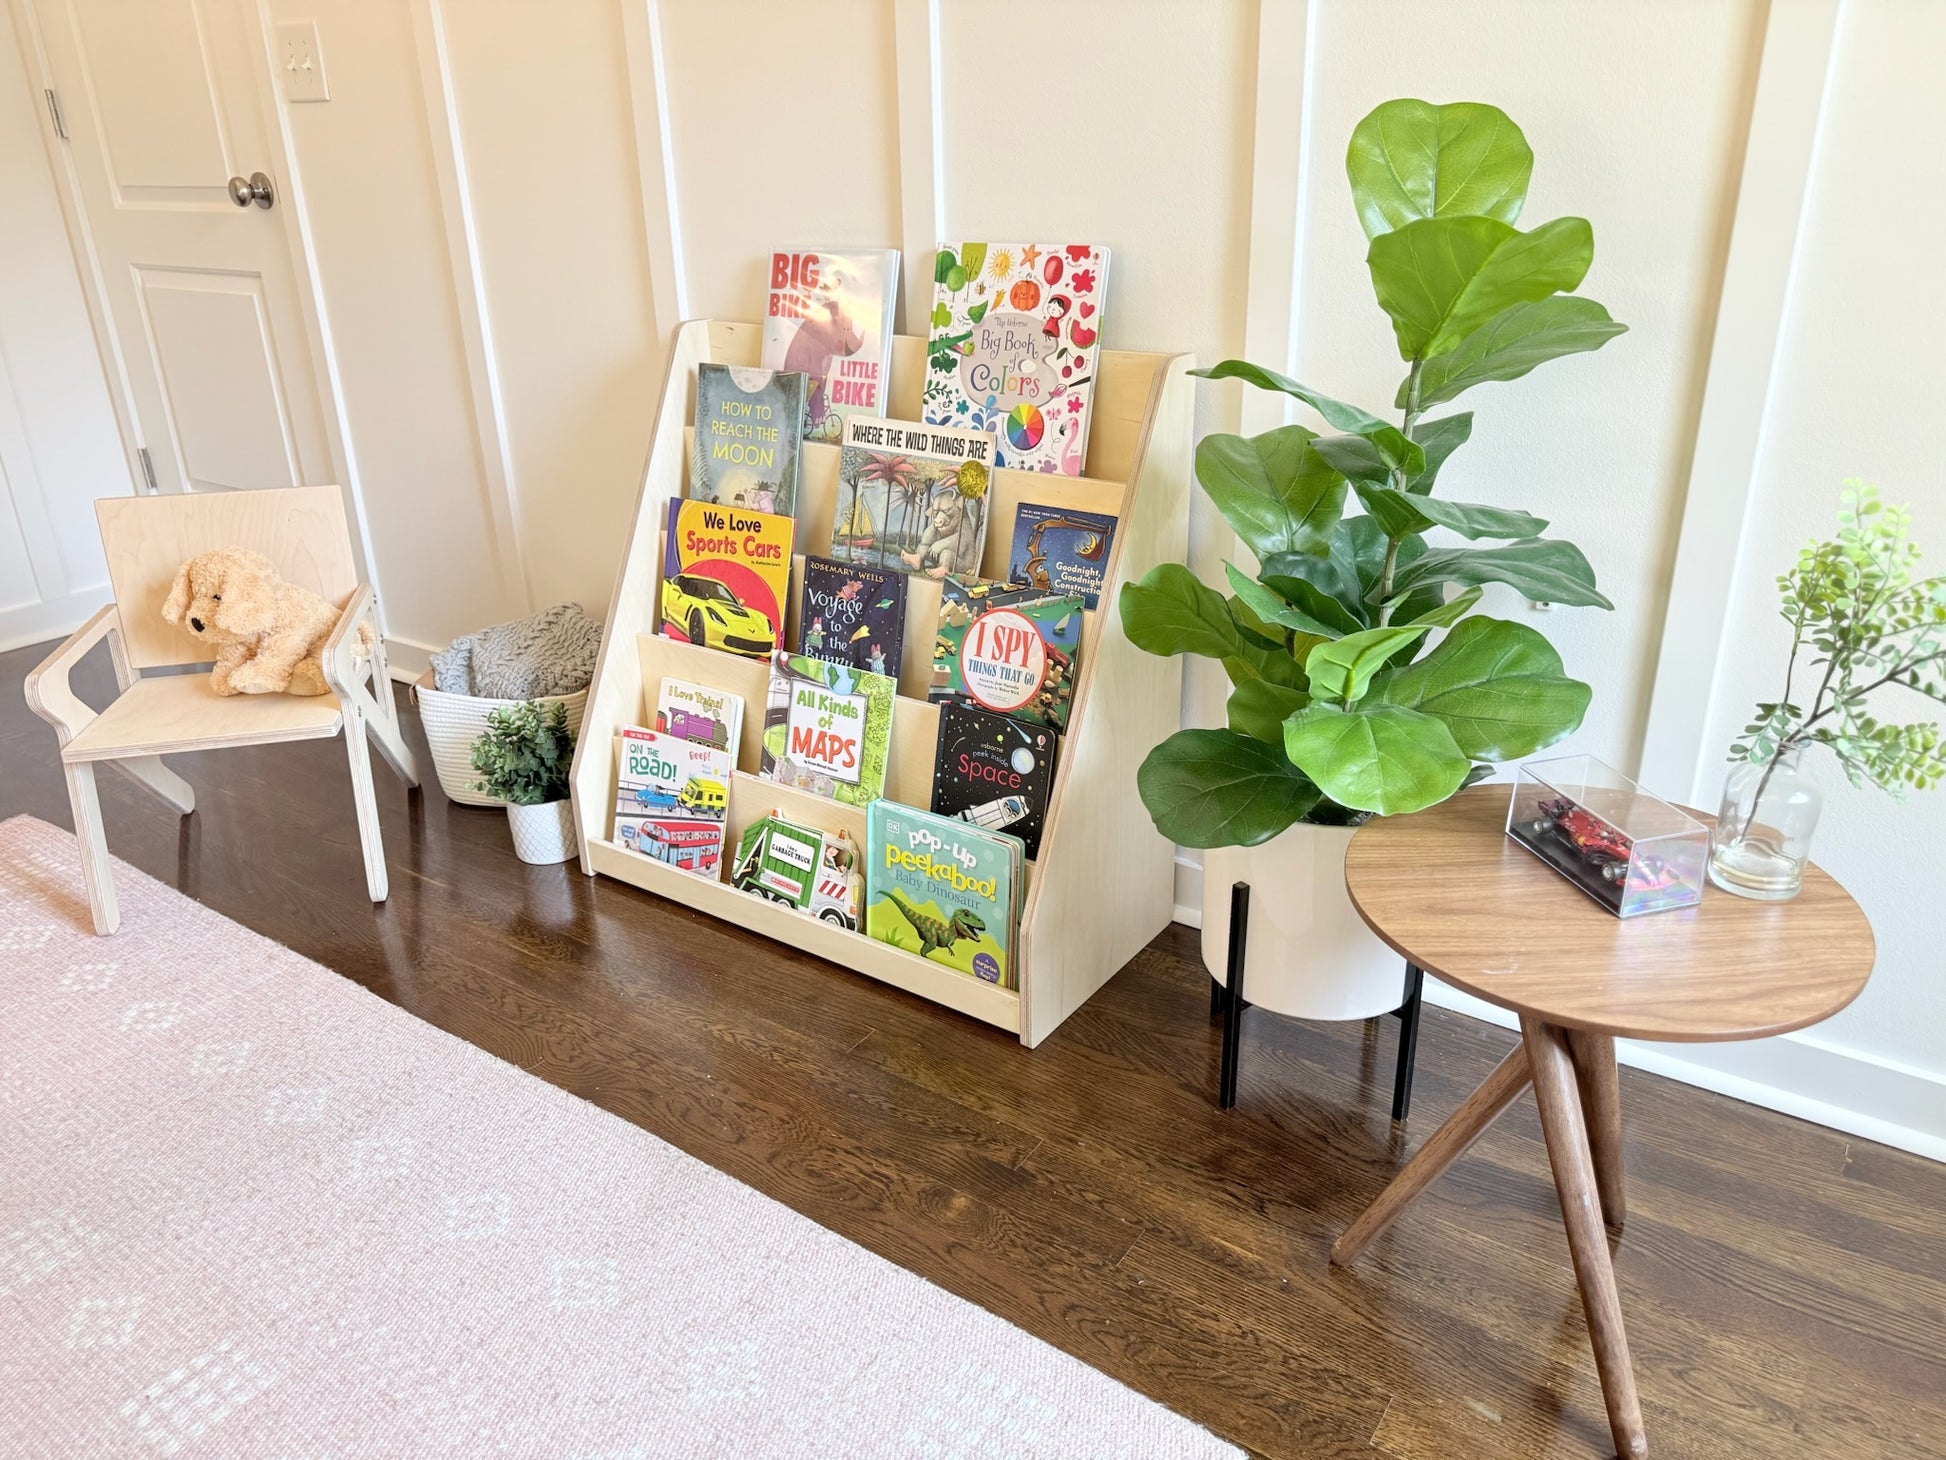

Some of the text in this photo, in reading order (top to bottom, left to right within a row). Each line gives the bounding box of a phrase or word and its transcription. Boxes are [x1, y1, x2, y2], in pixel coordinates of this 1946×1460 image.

[771, 253, 820, 290] BIG
[980, 329, 1039, 359] Big Book
[840, 360, 878, 379] LITTLE
[1009, 353, 1019, 373] of
[970, 364, 1040, 398] Colors
[831, 380, 876, 408] BIKE
[721, 400, 772, 420] HOW TO
[711, 420, 778, 442] REACH THE
[852, 424, 988, 460] WHERE THE WILD THINGS ARE
[712, 442, 774, 468] MOON
[704, 511, 762, 533] We Love
[686, 530, 781, 559] Sports Cars
[811, 562, 884, 582] ROSEMARY WELLS
[1056, 562, 1100, 578] Goodnight,
[808, 588, 862, 624] Voyage
[830, 620, 842, 632] to
[829, 636, 847, 652] the
[974, 621, 1036, 668] I SPY
[968, 658, 1036, 687] THINGS THAT GO
[668, 686, 724, 710] I Love Trains!
[796, 690, 858, 720] All Kinds
[818, 714, 834, 730] of
[630, 744, 660, 758] ON THE
[689, 751, 710, 762] Beep!
[792, 726, 856, 768] MAPS
[972, 750, 1008, 768] peek inside
[980, 742, 1004, 754] usborne
[958, 754, 1021, 788] Space
[888, 820, 898, 832] DK
[886, 844, 996, 902] peekaboo!
[895, 869, 981, 910] Baby Dinosaur
